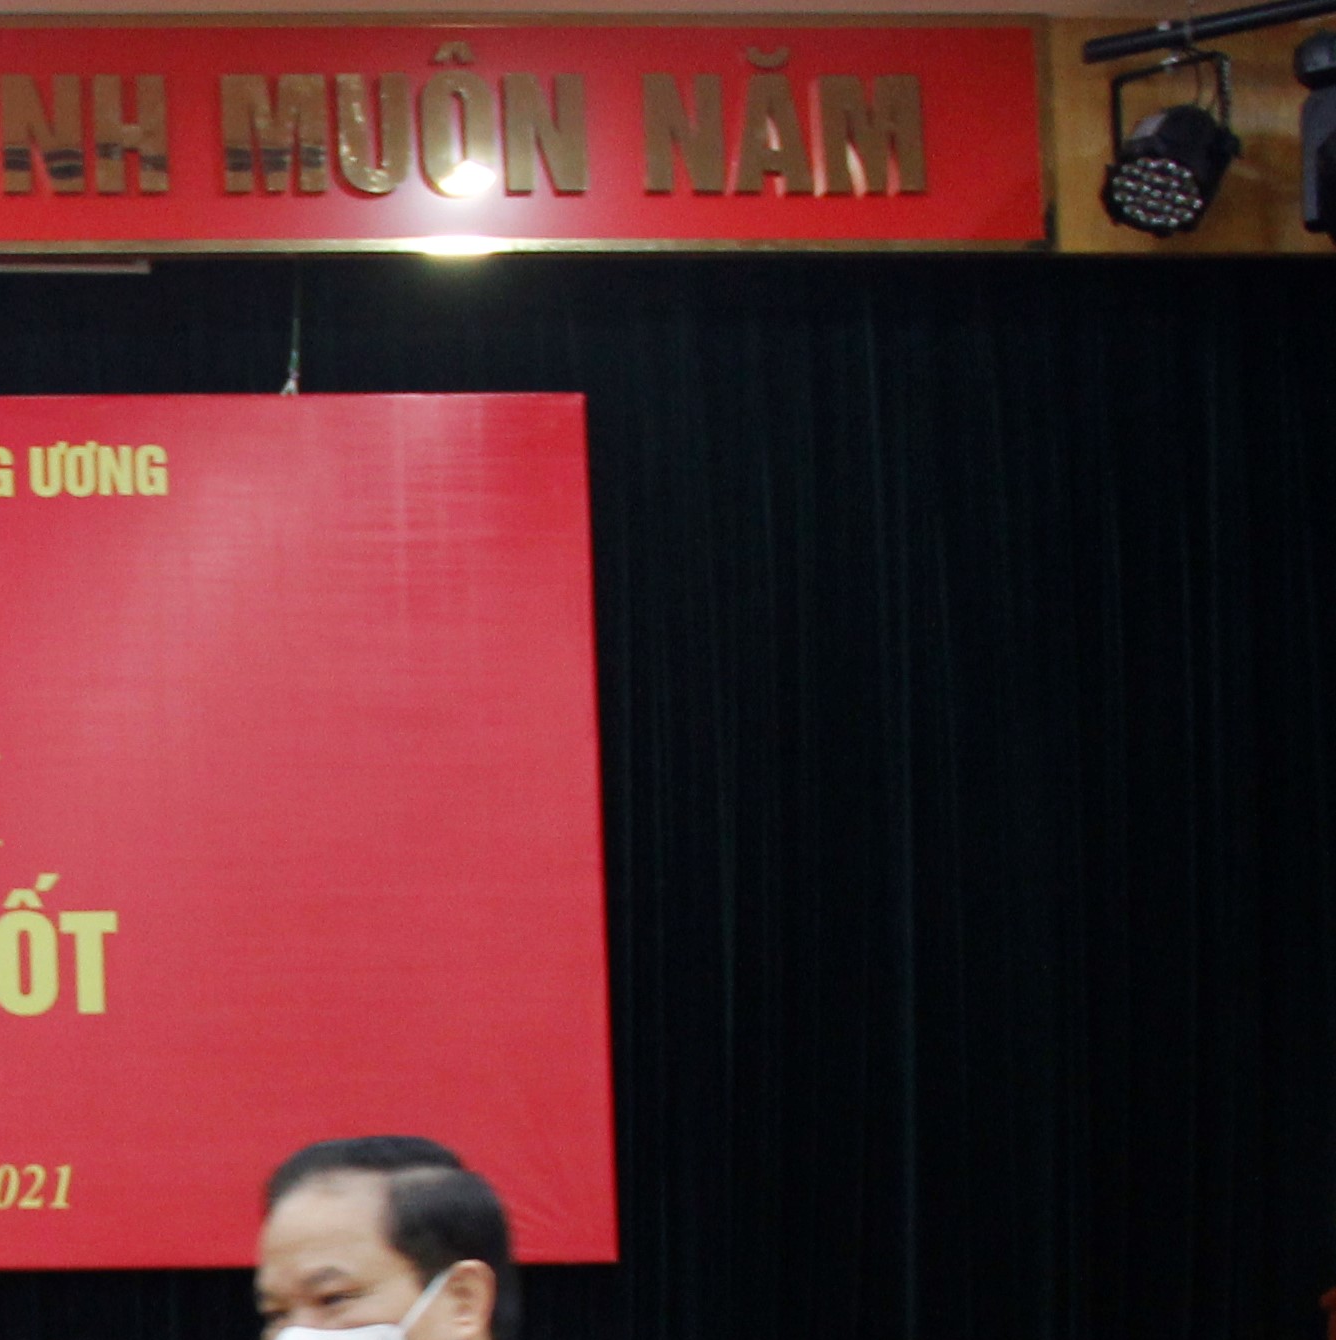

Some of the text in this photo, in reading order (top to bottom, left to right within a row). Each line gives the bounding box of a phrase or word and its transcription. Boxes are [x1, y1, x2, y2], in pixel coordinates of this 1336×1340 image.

[219, 39, 588, 198] MUÔN
[642, 45, 927, 198] NĂM
[28, 441, 169, 498] ƯƠNG
